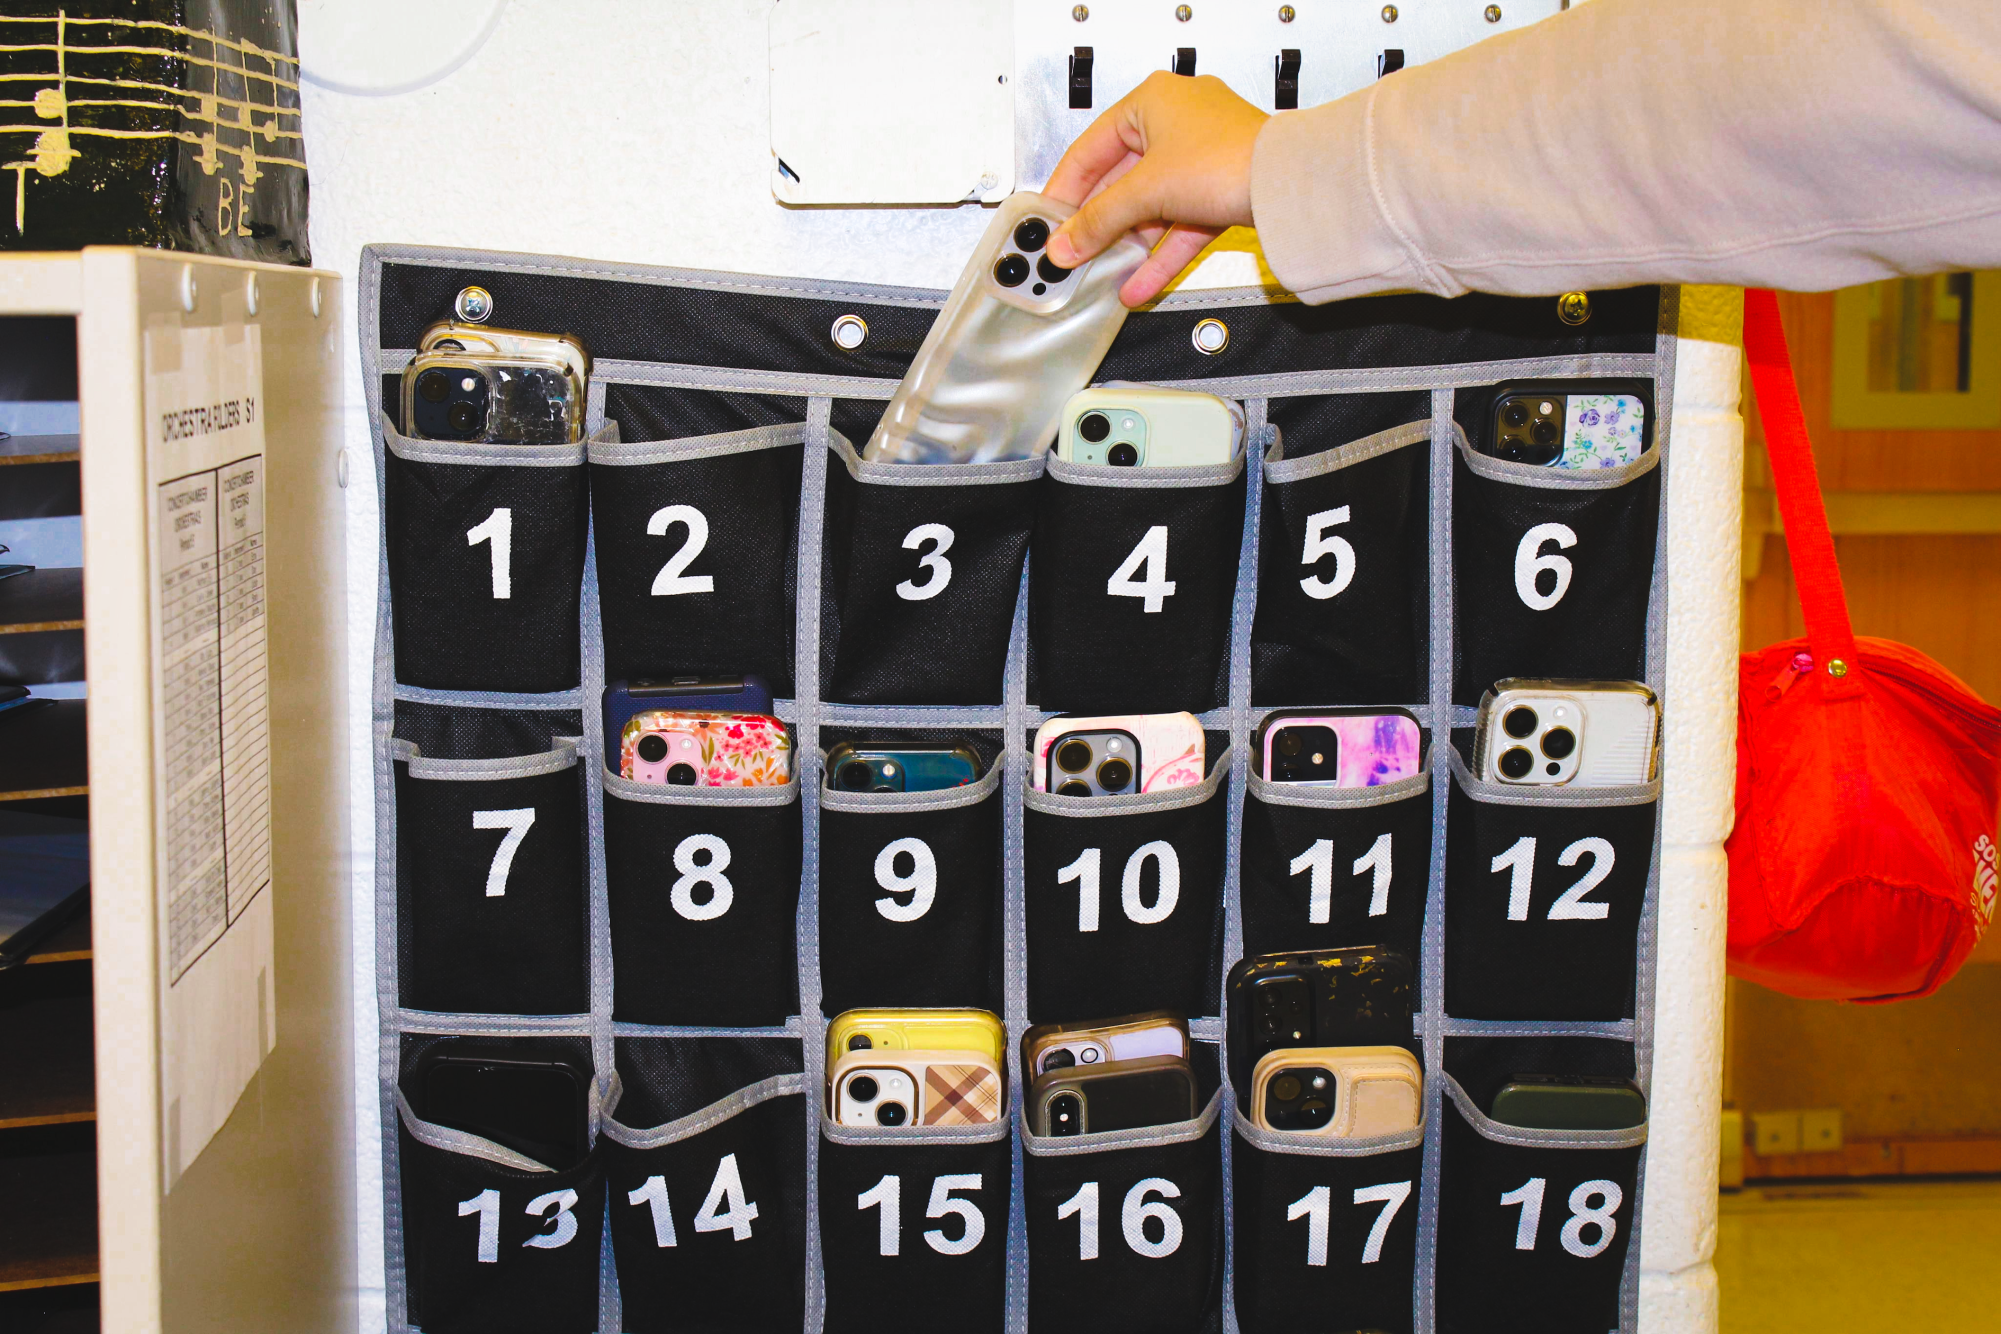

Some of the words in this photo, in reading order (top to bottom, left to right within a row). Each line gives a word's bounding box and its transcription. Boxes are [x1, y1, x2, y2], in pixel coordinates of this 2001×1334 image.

[218, 177, 255, 237] BE
[162, 407, 212, 442] ORCHESTRA
[467, 508, 512, 599] 1
[647, 505, 714, 595] 2
[896, 523, 954, 600] 3
[1107, 526, 1176, 613] 4
[1300, 505, 1356, 599] 5
[1515, 523, 1577, 611] 6
[473, 808, 535, 897] 7
[670, 834, 733, 921] 8
[874, 838, 937, 922] 9
[1058, 840, 1180, 932] 10
[1290, 833, 1392, 923] 11
[1491, 837, 1615, 921] 12
[458, 1189, 578, 1262] 13
[628, 1153, 758, 1247] 14
[858, 1174, 985, 1256] 15
[1058, 1178, 1183, 1260] 16
[1287, 1181, 1411, 1266] 17
[1500, 1178, 1622, 1258] 18
